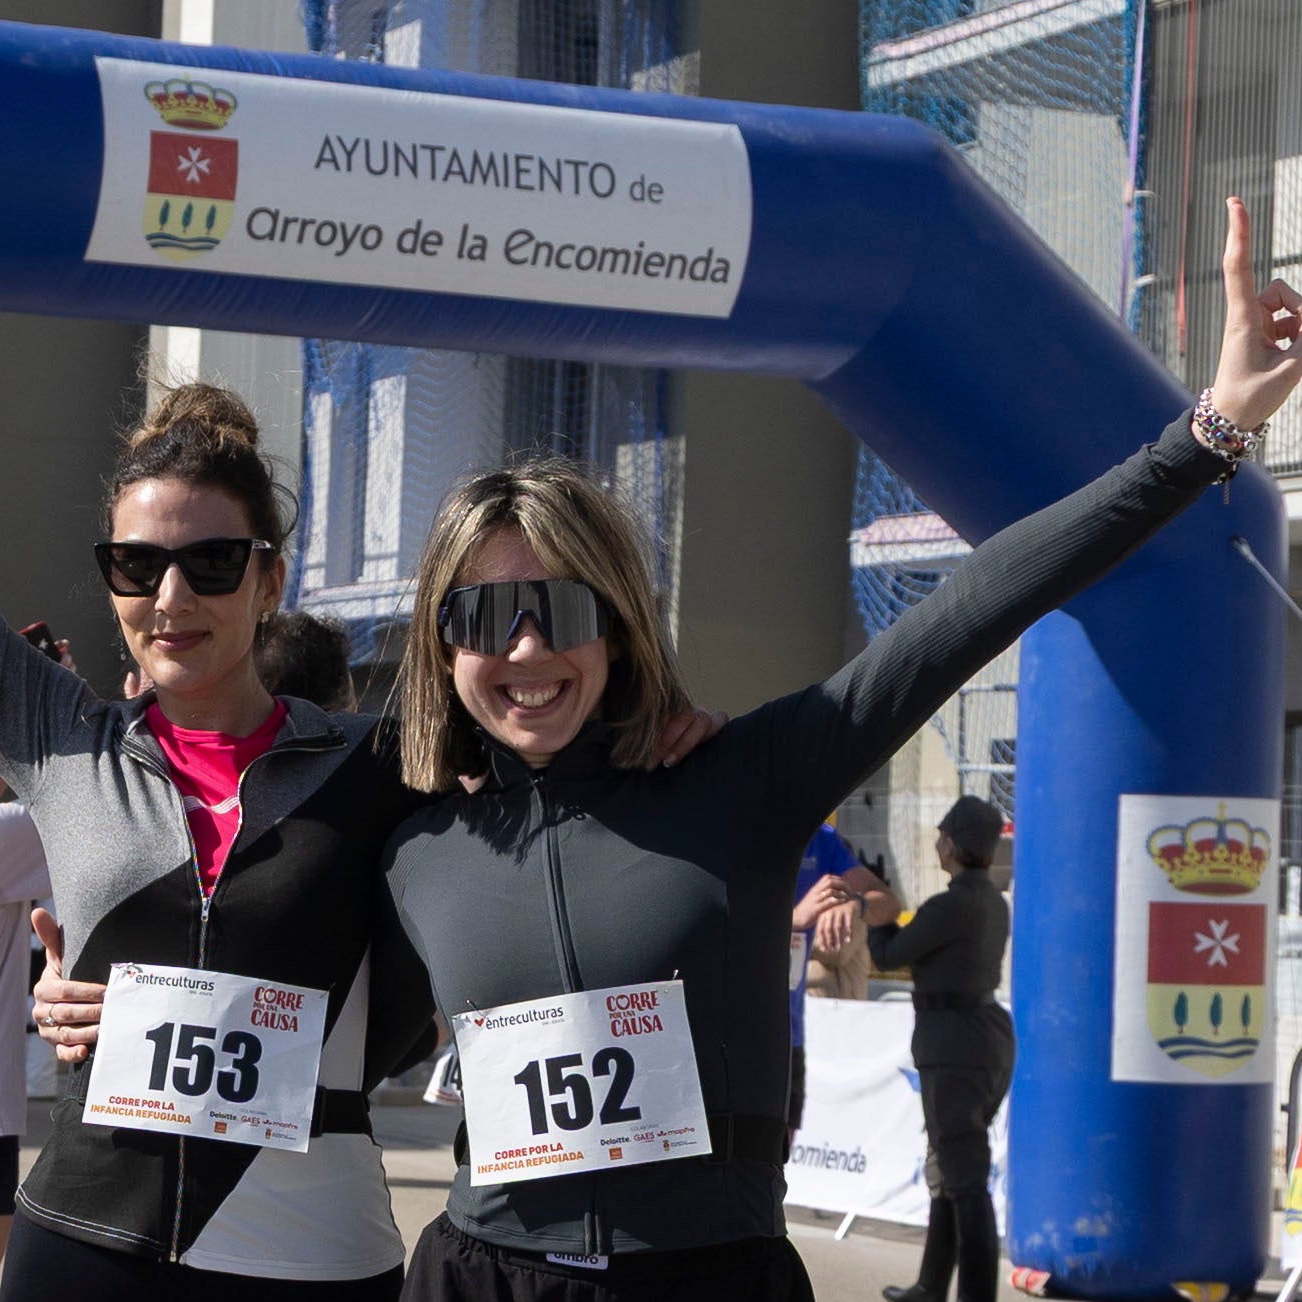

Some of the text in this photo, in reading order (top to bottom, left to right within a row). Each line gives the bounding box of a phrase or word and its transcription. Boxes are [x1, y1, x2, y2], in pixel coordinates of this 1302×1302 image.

[314, 134, 664, 203] AYUNTAMIENTO de
[397, 219, 443, 257] de
[457, 224, 487, 262] la
[135, 973, 215, 992] entreculturas
[254, 986, 305, 1010] CORRE
[606, 991, 660, 1012] CORRE
[251, 1009, 298, 1032] CAUSA
[485, 1006, 564, 1030] entreculturas
[611, 1015, 664, 1037] CAUSA
[145, 1022, 263, 1103] 153
[513, 1046, 642, 1135] 152
[90, 1104, 192, 1125] INFANCIA REFUGIADA
[109, 1096, 175, 1111] CORRE POR LA
[477, 1151, 585, 1174] INFANCIA REFUGIADA
[494, 1142, 564, 1161] CORRE POR LA
[791, 1142, 867, 1174] omienda
